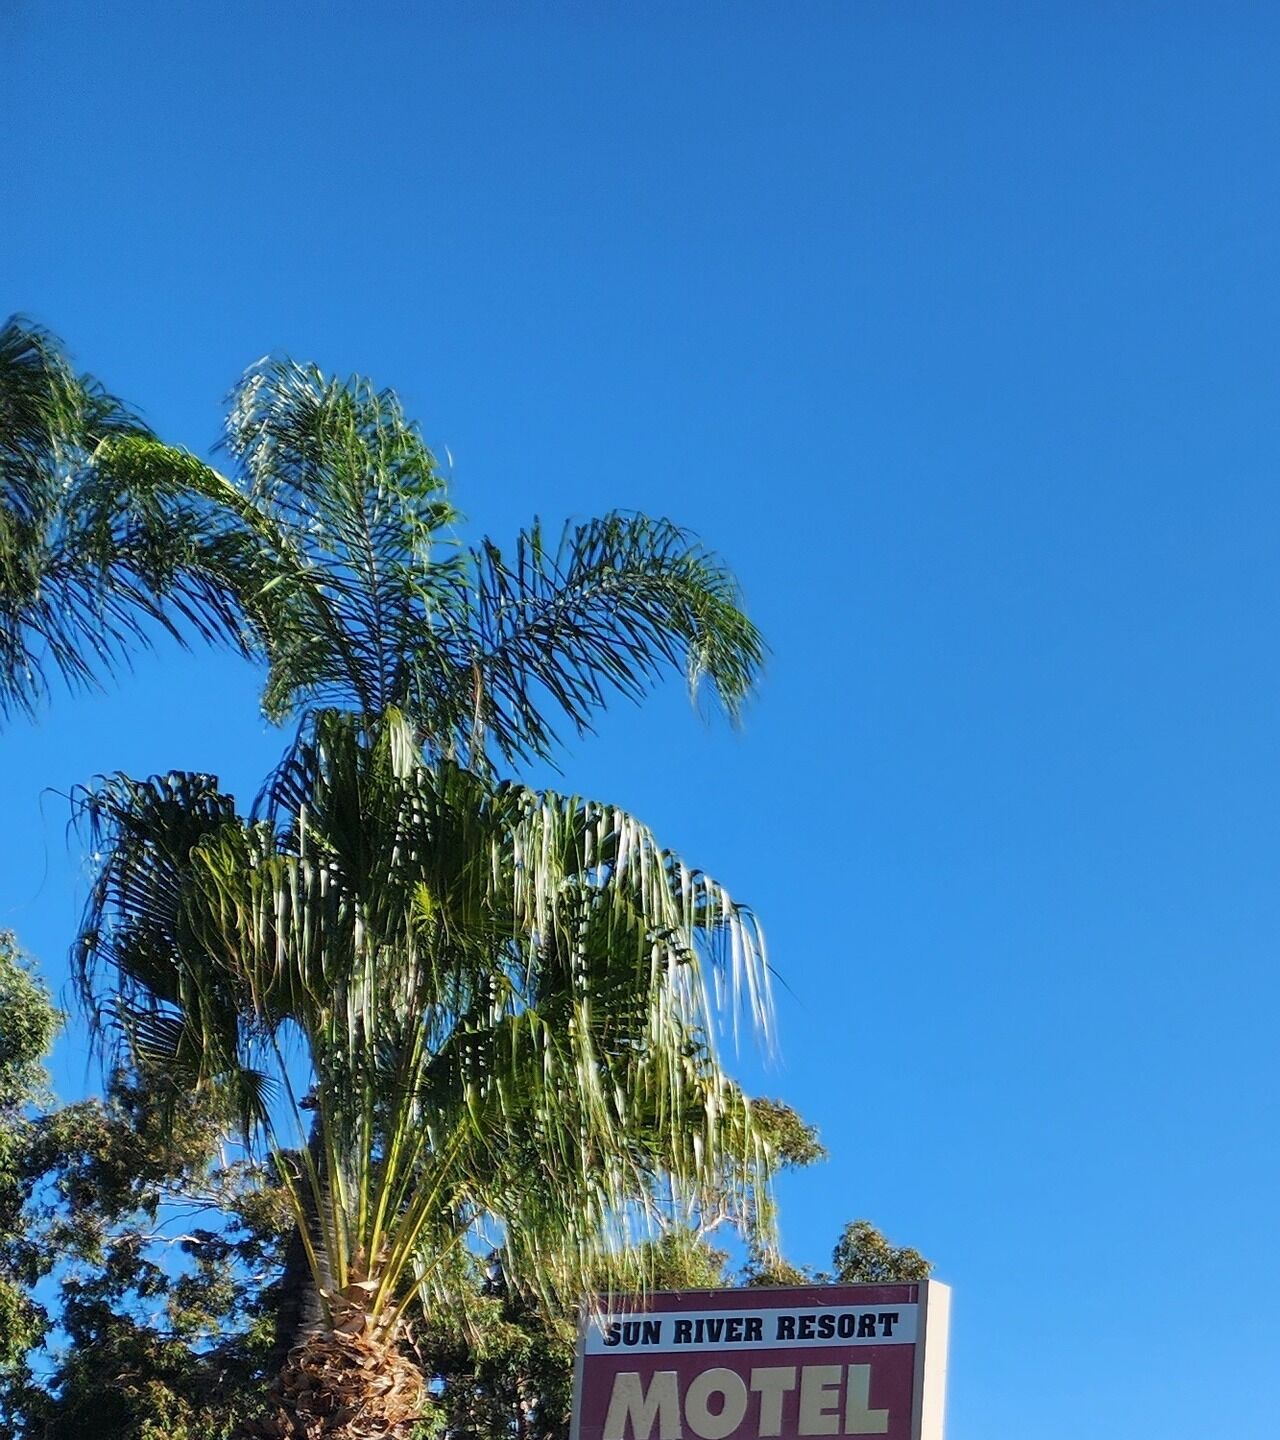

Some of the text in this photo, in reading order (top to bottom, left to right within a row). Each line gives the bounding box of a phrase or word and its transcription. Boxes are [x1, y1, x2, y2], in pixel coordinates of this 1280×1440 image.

[603, 1312, 899, 1346] SUN RIVER RESORT
